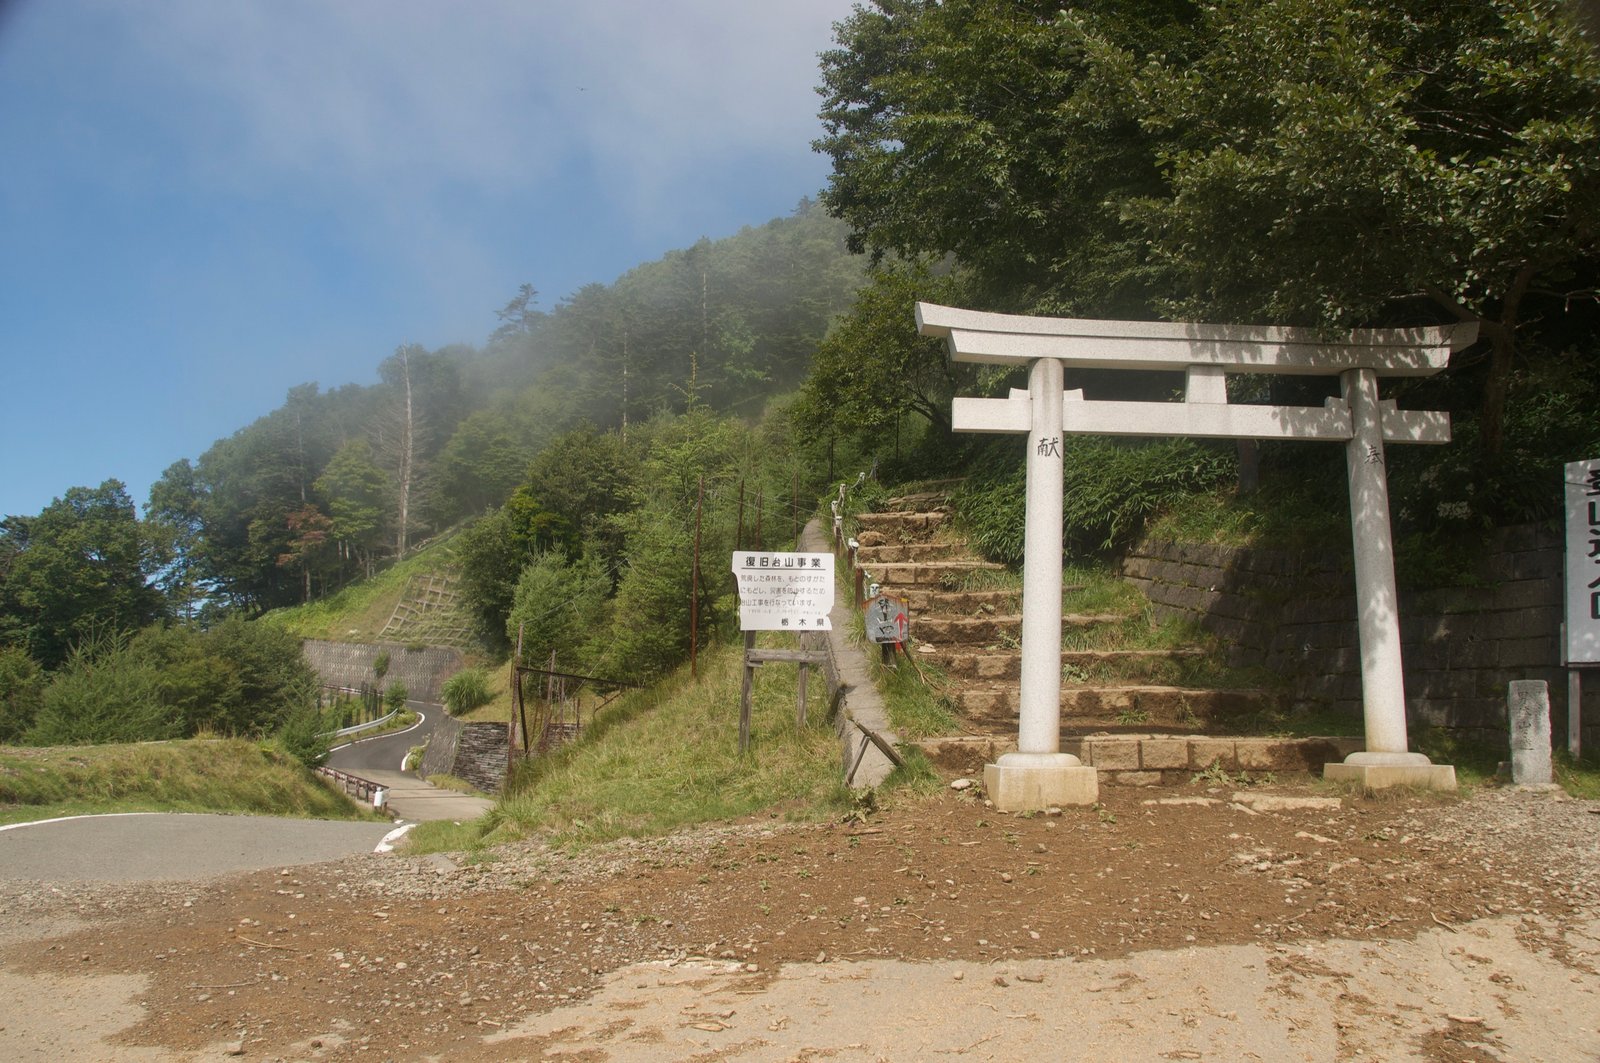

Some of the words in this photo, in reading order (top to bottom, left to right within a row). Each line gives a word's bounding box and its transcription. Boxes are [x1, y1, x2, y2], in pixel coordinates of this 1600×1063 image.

[1037, 437, 1061, 459] 献
[1364, 444, 1384, 465] 奉
[745, 556, 821, 568] 復旧治山事業
